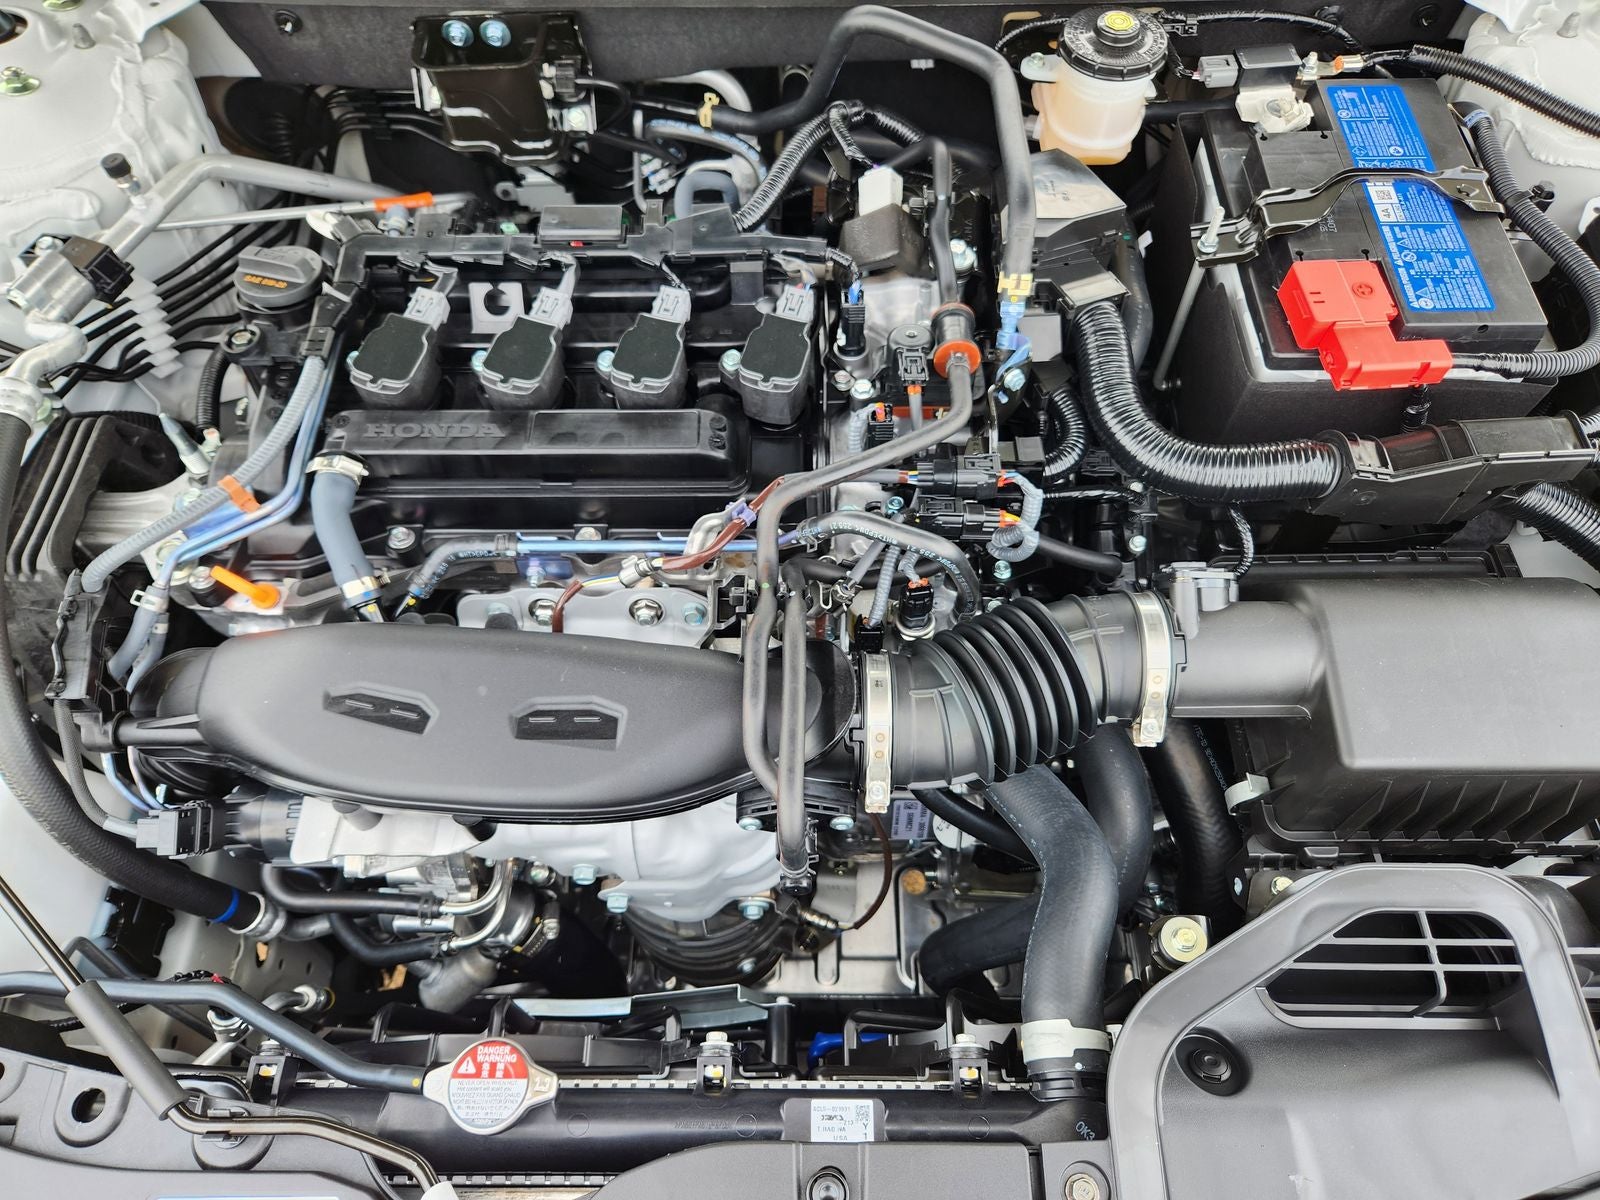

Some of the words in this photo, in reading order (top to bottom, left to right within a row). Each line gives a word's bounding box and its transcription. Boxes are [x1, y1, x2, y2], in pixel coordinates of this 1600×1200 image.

[1380, 207, 1393, 218] 4A
[364, 423, 505, 438] HONDA
[477, 1045, 511, 1054] DANGER
[477, 1054, 517, 1063] WARNUNG
[862, 1122, 869, 1130] Y
